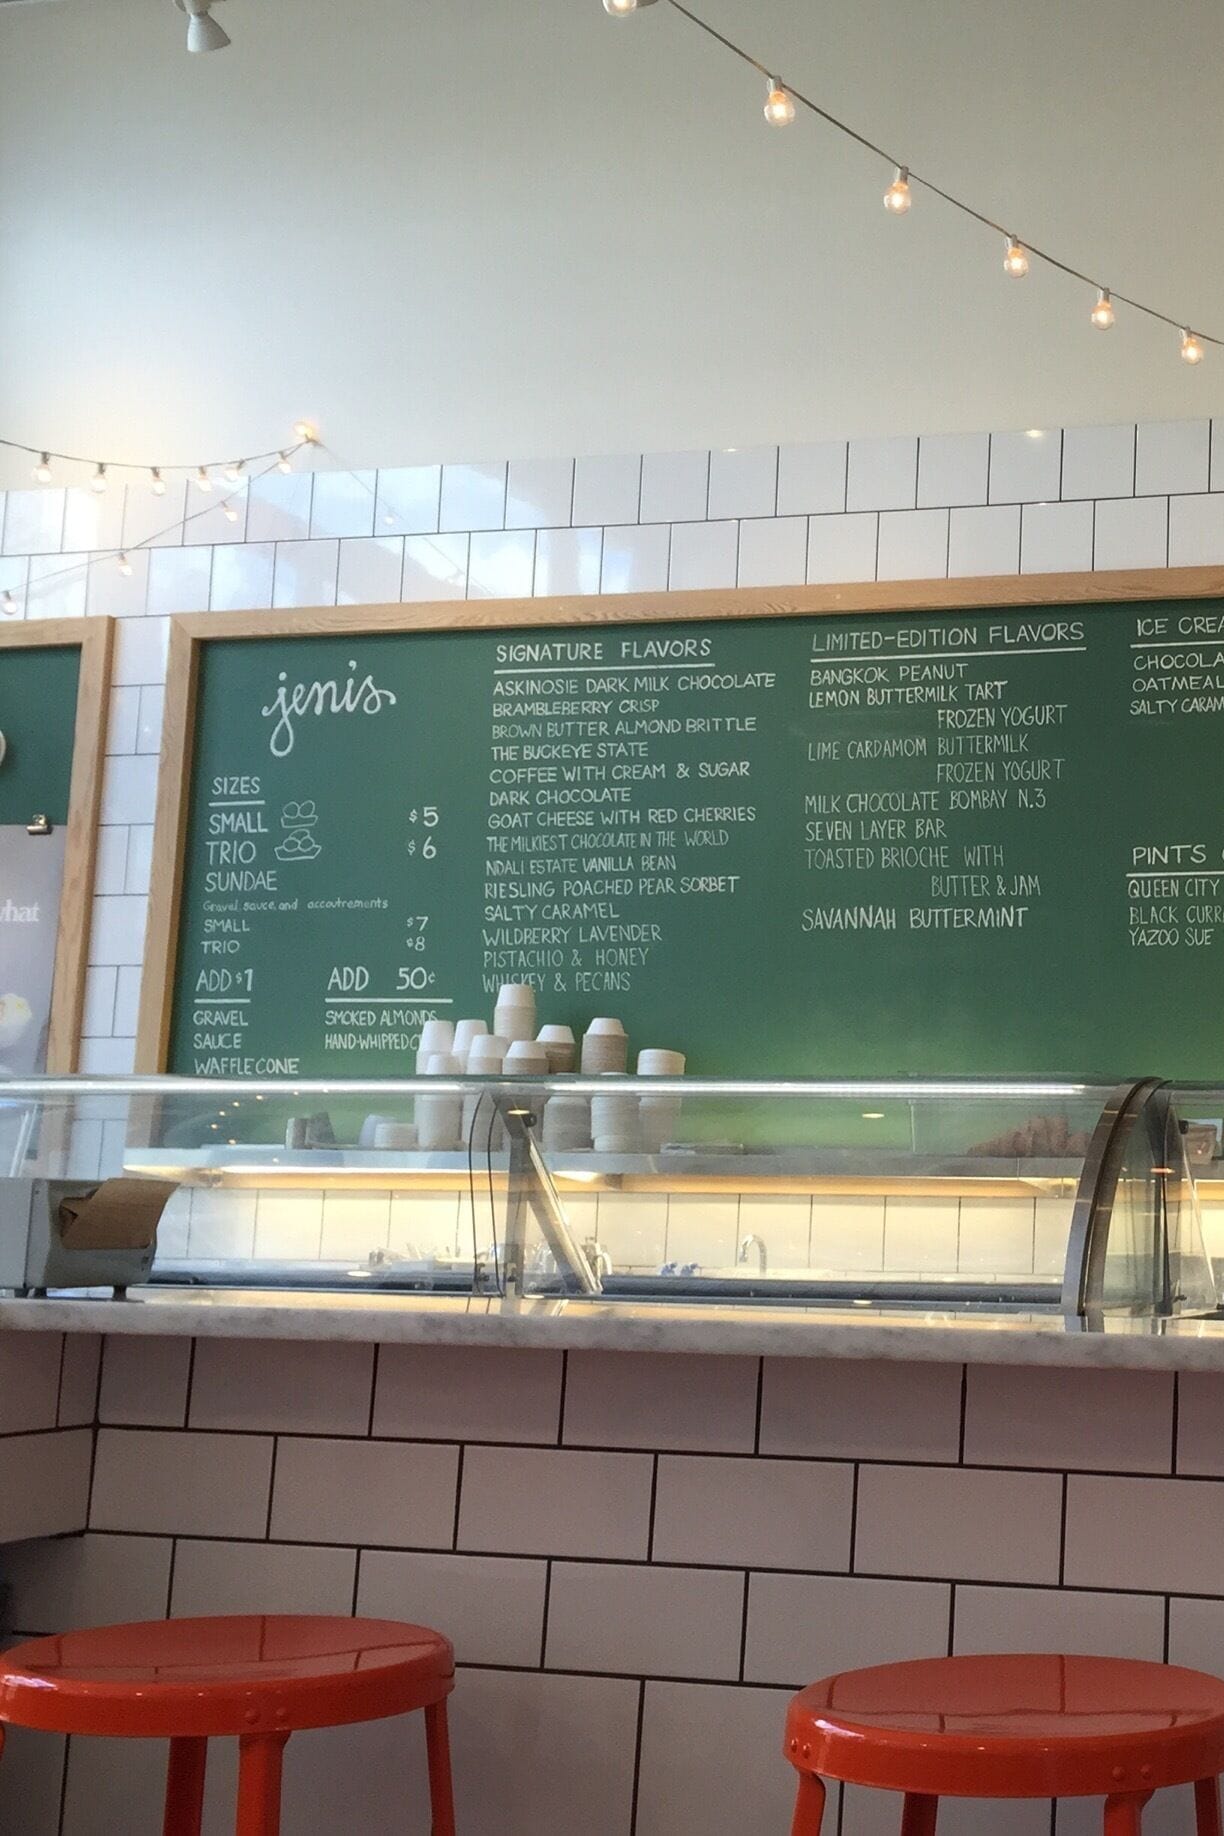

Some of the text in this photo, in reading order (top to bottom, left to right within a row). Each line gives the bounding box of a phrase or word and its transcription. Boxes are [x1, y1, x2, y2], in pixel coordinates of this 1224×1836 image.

[812, 622, 1084, 651] LIMITED-EDITION FLAVORS
[1137, 618, 1168, 636] ICE
[497, 639, 712, 662] SIGNATURE FLAVORS
[493, 673, 776, 696] ASKINOSIE DARK MILK CHOCOLATE
[811, 663, 968, 686] BANGKOK PEANUT
[809, 680, 1008, 708] LEMON BUTTERMILK TART
[262, 660, 396, 757] jeni's
[493, 699, 659, 717] BRAMBLEBERRY CRISP
[937, 704, 1068, 728] FROZEN YOGURT
[1130, 699, 1178, 715] SALTY
[492, 717, 756, 739] BROWN BUTTER ALMOND BRITTLE
[491, 742, 648, 761] THE BUCKEYE STATE
[489, 761, 750, 784] COFFEE WITH CREAM & SUGAR
[212, 776, 260, 795] SIZES
[490, 787, 631, 806] DARK CHOCOLATE
[805, 795, 840, 814] MILK
[846, 791, 939, 813] CHOCOLATE
[949, 789, 1007, 809] BOMBAY
[209, 807, 439, 835] SMALL $5
[488, 807, 756, 829] GOAT CHEESE WITH RED CHERRIES
[806, 818, 947, 841] SEVEN LAYER BAR
[205, 836, 436, 865] TRIO $6
[1133, 845, 1206, 865] PINTS
[205, 870, 277, 892] SUNDAE
[485, 876, 740, 899] RIESLING POACHED PEAR SORBET
[1128, 879, 1179, 898] QUEEN
[1185, 878, 1220, 896] CITY
[0, 899, 40, 922] hat
[485, 902, 620, 922] SALTY CARAMEL
[802, 905, 1028, 931] SAVANNAH BUTTERMINT
[204, 916, 428, 933] SMALL $7
[482, 924, 662, 946] WILDBERRY LAVENDER
[200, 936, 425, 954] TRIO $8
[196, 969, 253, 992] ADD $1
[328, 966, 369, 991] ADD
[193, 1010, 248, 1026] GRAVEL
[194, 1057, 300, 1074] WAFFLE CONE
